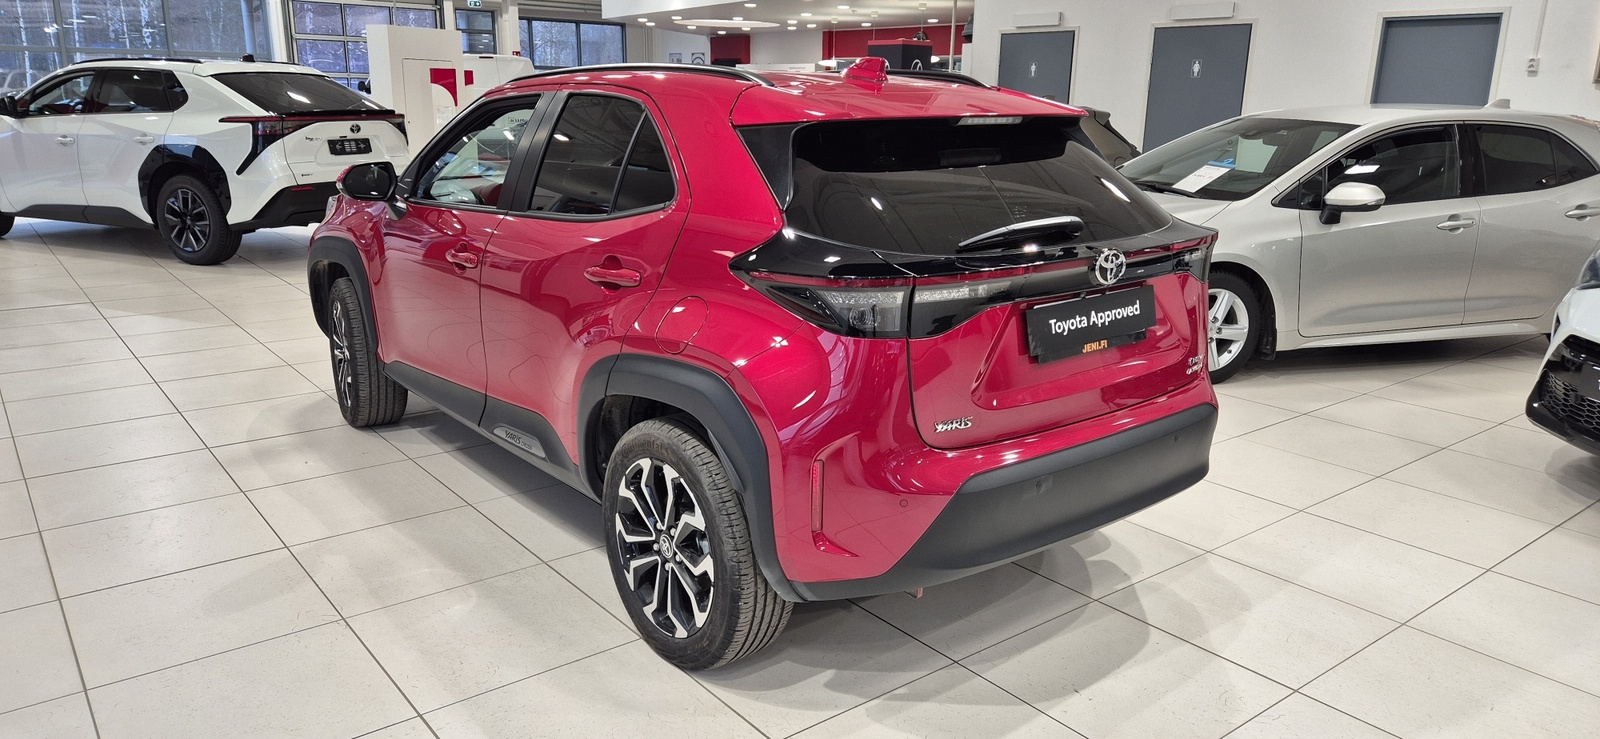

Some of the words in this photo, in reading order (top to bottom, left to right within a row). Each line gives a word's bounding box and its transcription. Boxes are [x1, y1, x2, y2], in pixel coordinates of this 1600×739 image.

[1048, 315, 1088, 336] Toyota
[1089, 299, 1141, 327] Approved
[1082, 339, 1108, 354] JENI.FI
[934, 416, 973, 433] YARIS
[505, 430, 521, 445] YARIS
